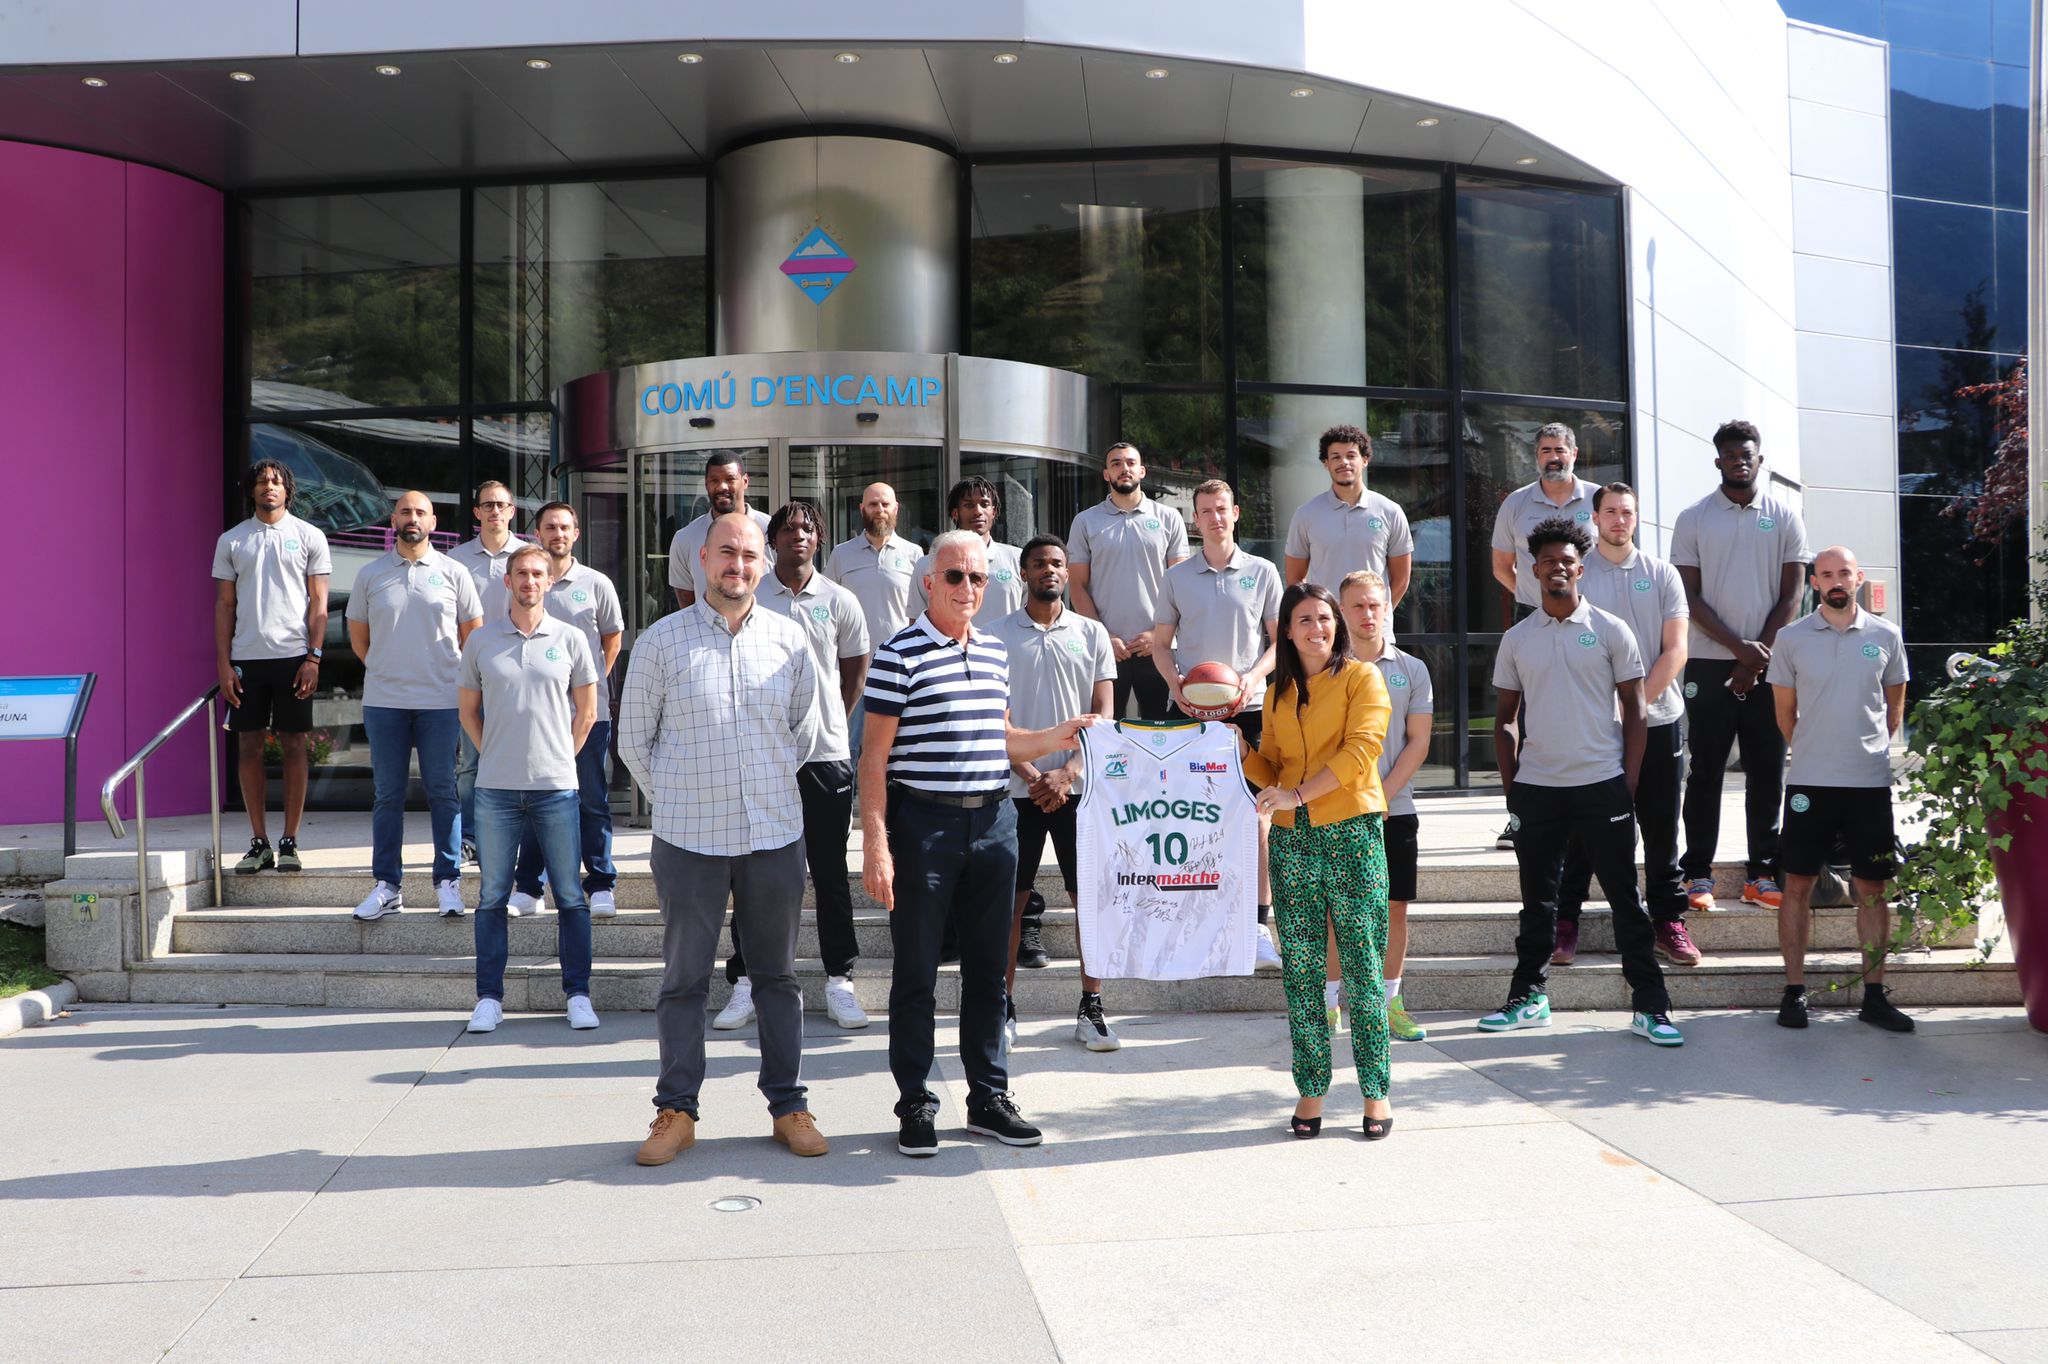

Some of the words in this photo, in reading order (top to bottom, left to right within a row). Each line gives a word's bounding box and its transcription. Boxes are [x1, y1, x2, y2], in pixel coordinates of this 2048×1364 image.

[641, 371, 736, 416] COMÚ
[751, 374, 942, 408] D'ENCAMP
[1189, 762, 1227, 772] BigMat
[1111, 799, 1222, 826] LIMOGES
[1145, 832, 1188, 866] 10
